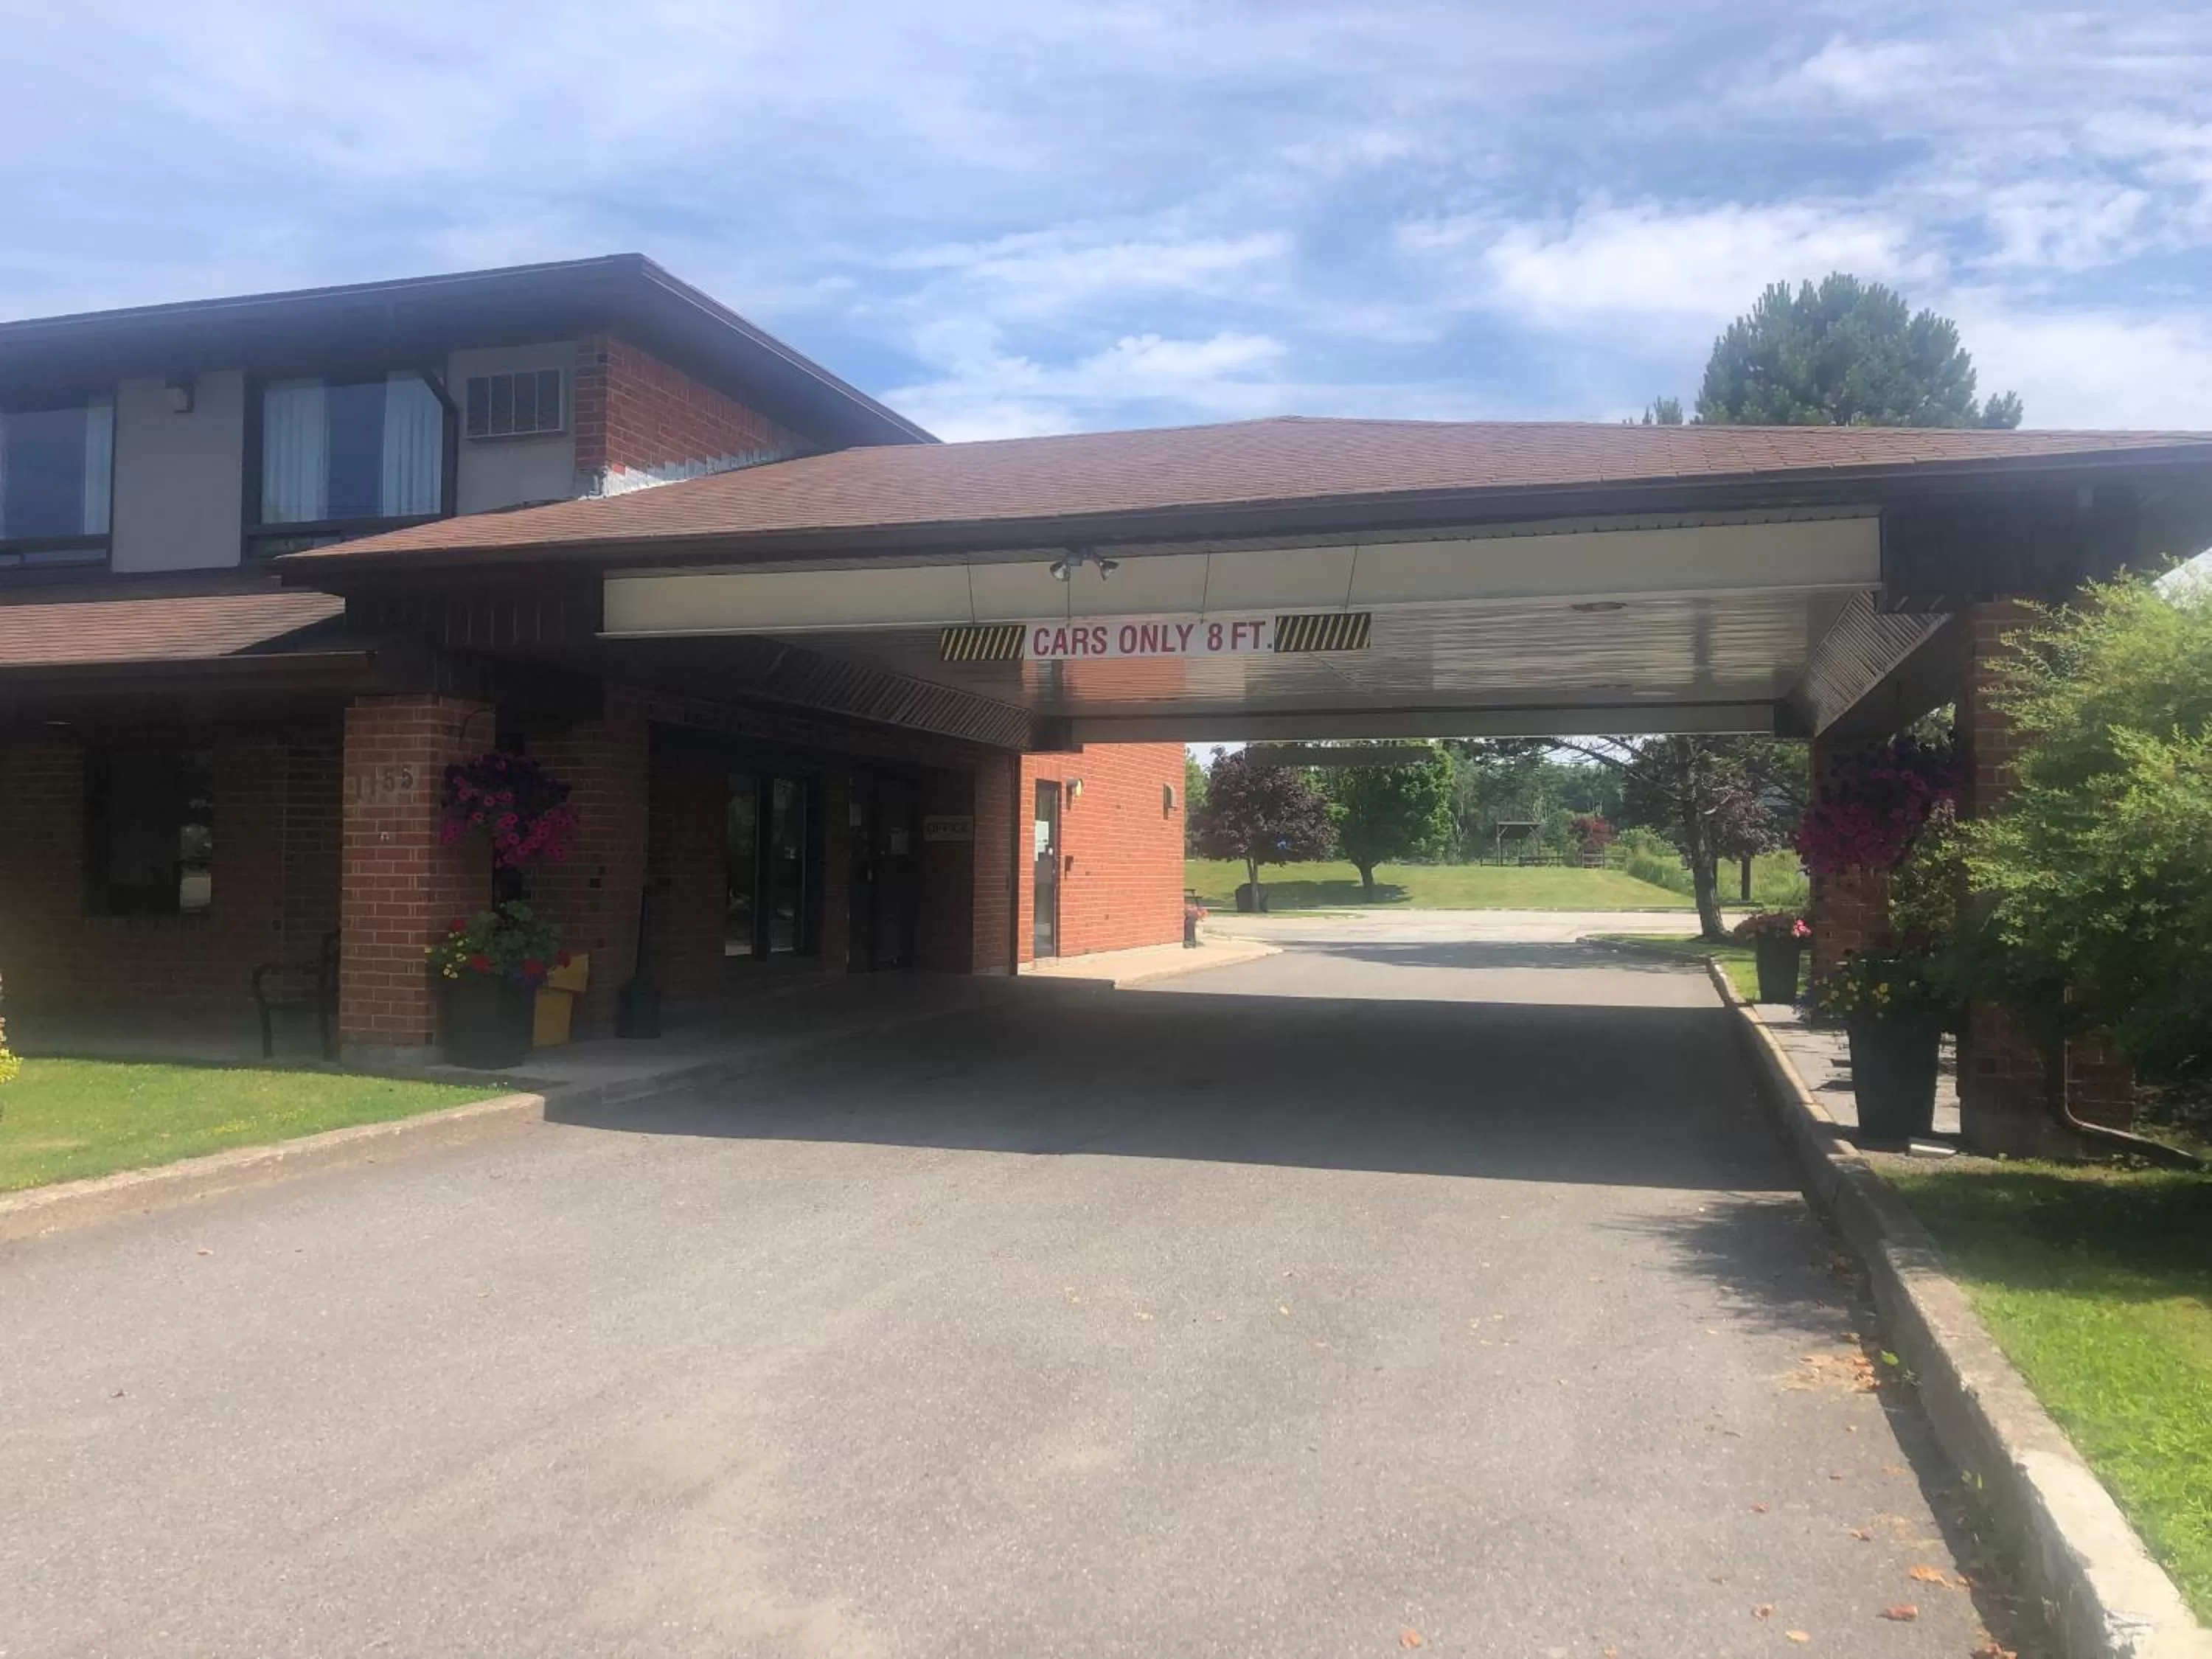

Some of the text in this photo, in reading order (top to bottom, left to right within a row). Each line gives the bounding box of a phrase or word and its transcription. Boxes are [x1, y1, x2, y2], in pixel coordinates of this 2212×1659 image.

[1033, 620, 1273, 655] CARS ONLY 8 FT.
